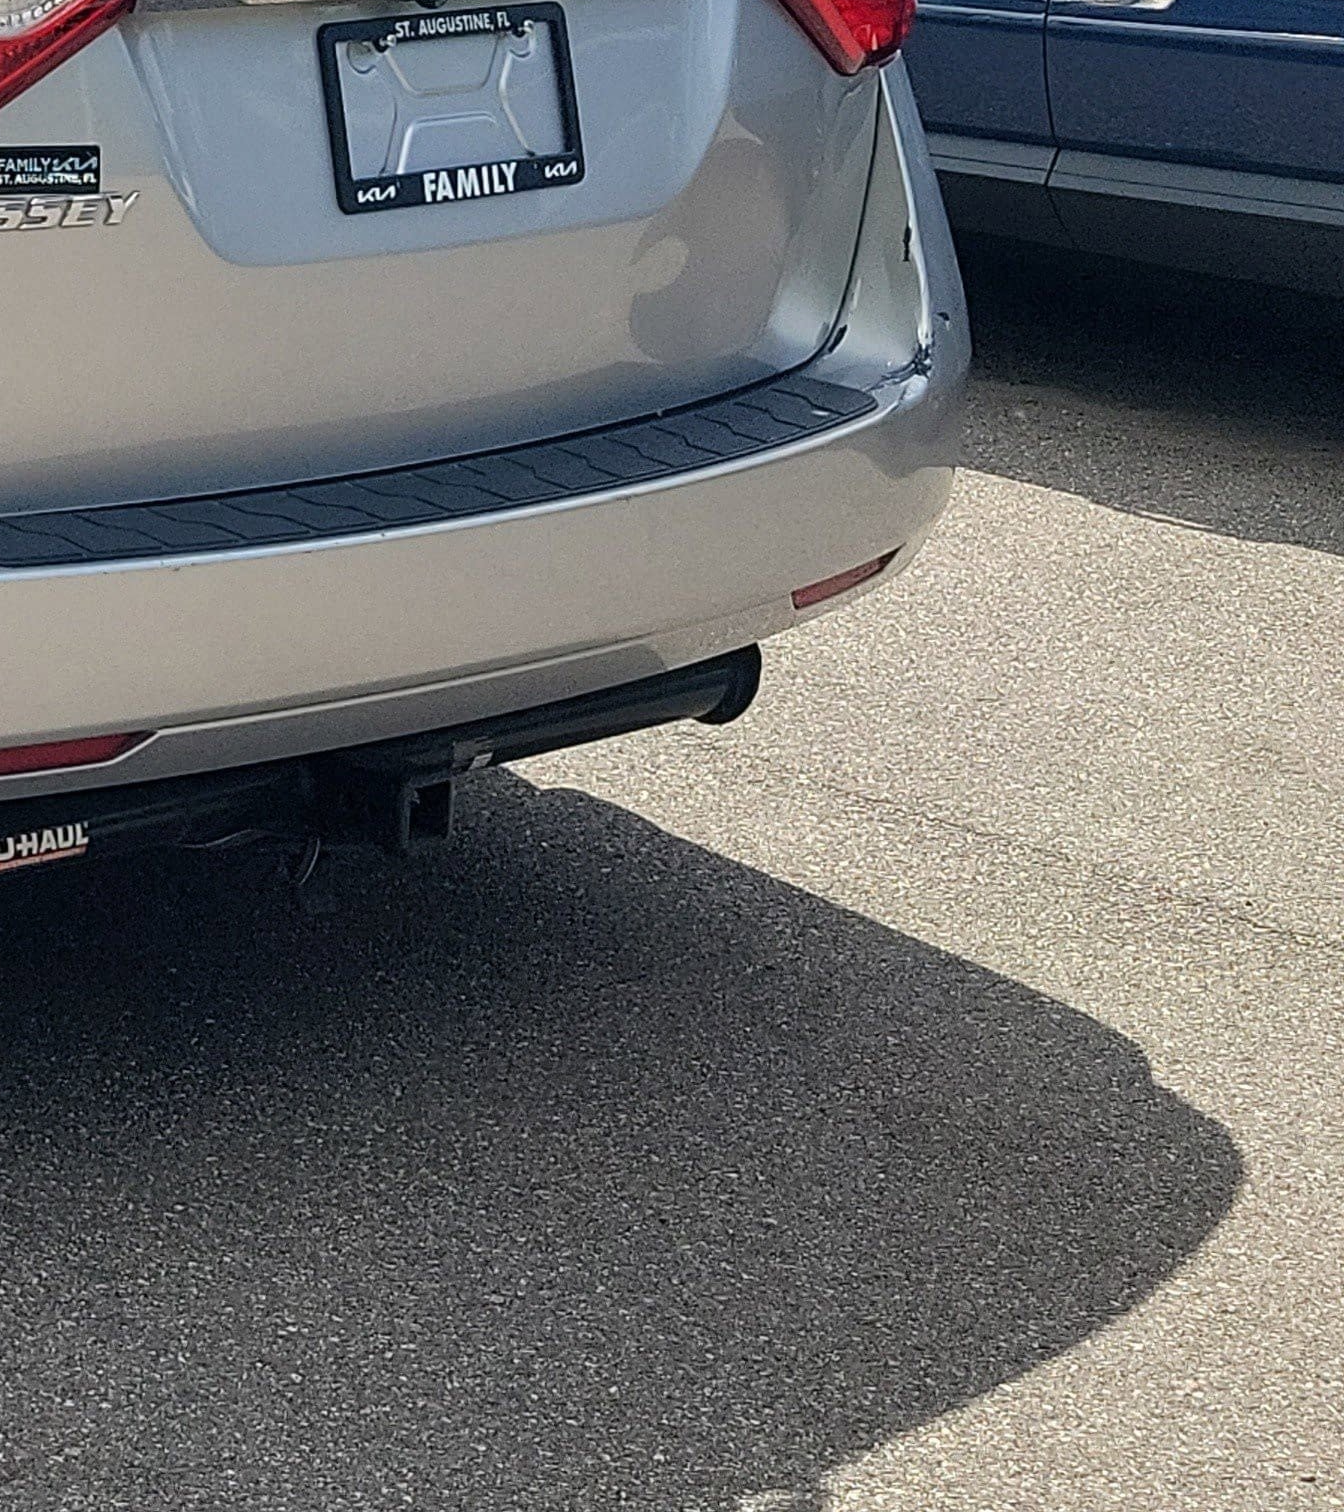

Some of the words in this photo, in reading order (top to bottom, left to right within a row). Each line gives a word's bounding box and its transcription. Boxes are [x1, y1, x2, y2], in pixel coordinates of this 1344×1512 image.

[394, 21, 414, 38] ST.
[418, 12, 494, 35] AUGUSTINE,
[497, 11, 511, 28] FL
[14, 172, 82, 185] AUGUSTINE,
[83, 172, 97, 184] FL
[422, 161, 518, 203] FAMILY
